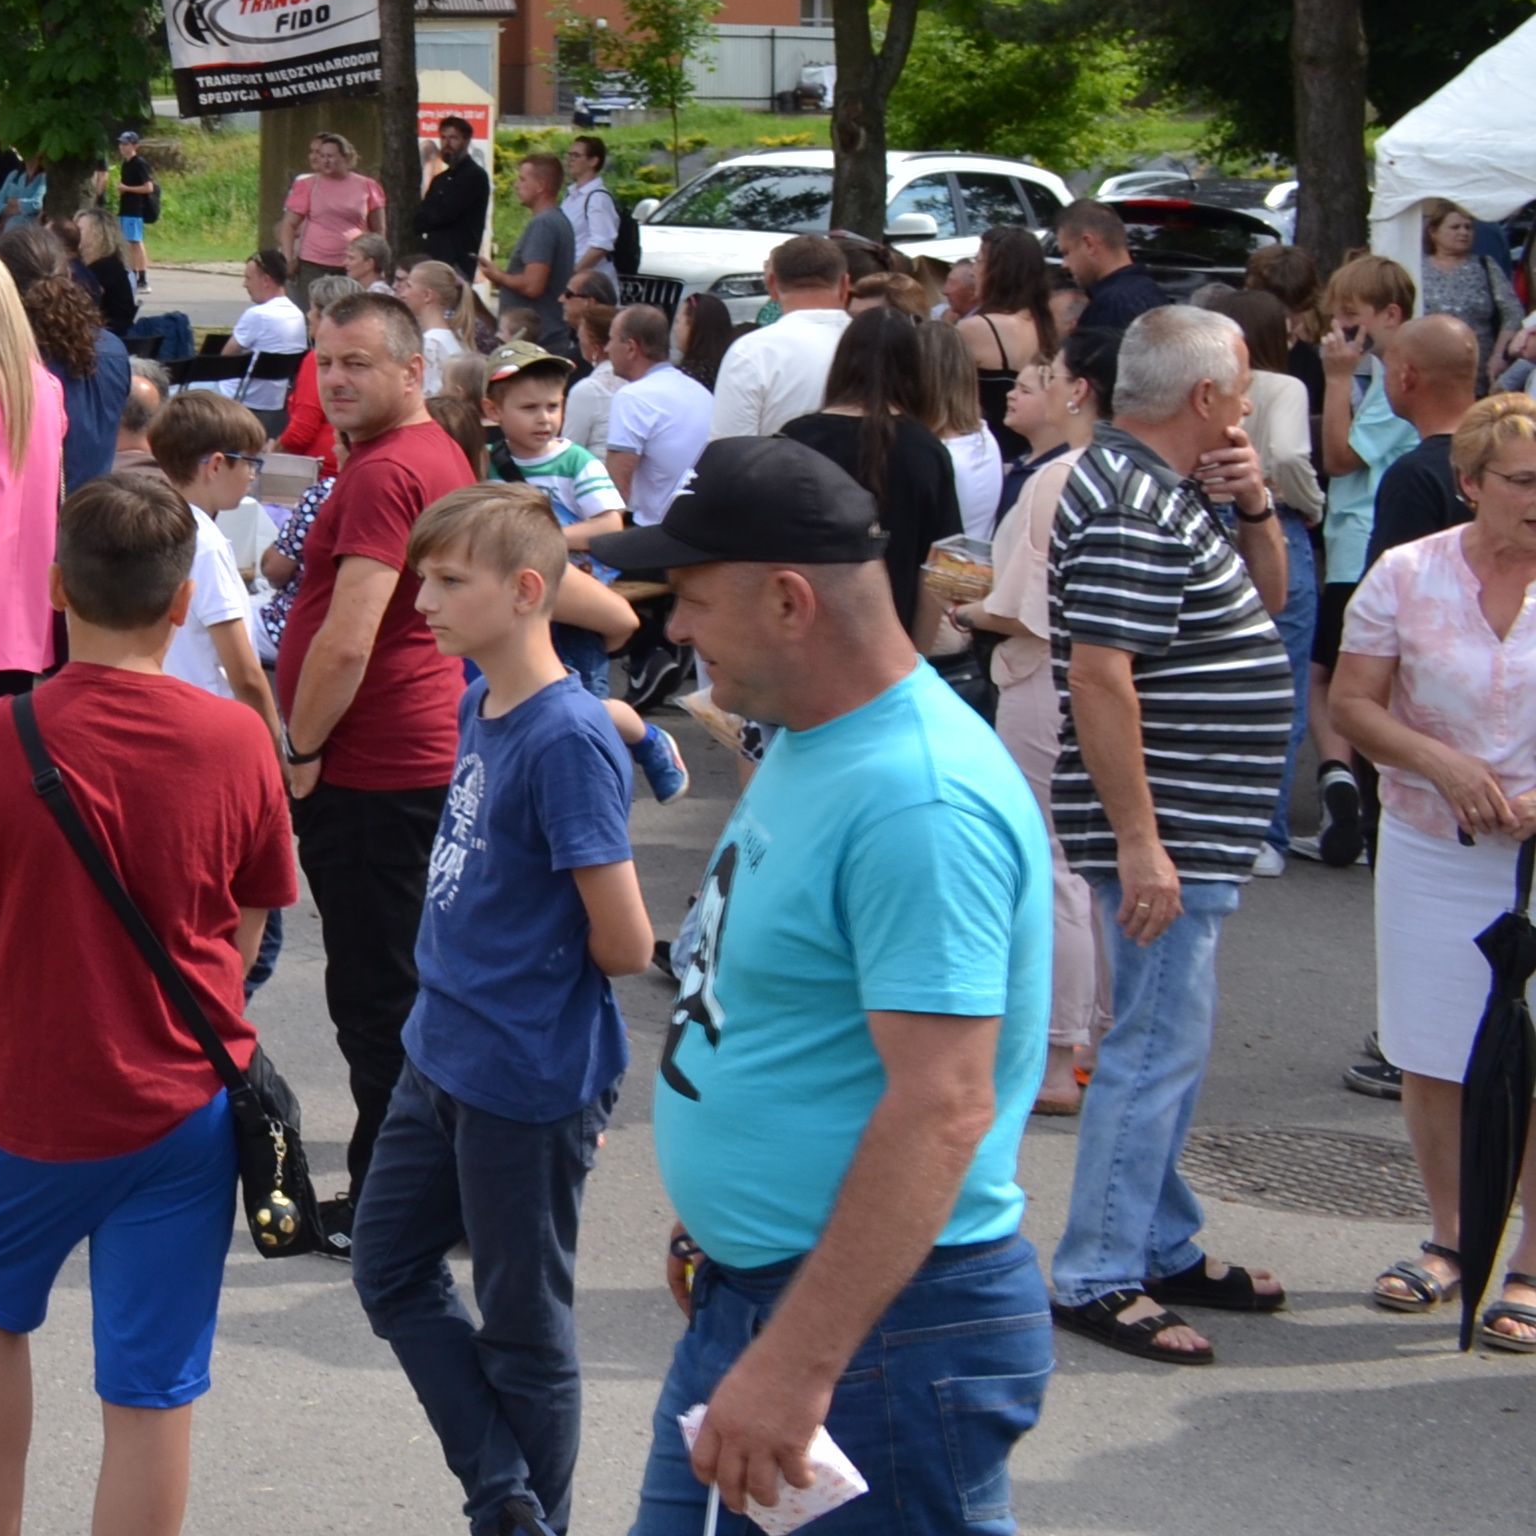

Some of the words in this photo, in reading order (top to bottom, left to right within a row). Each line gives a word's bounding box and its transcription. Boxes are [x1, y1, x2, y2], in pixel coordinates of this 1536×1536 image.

[275, 4, 331, 33] FIDO
[196, 73, 264, 88] TRANSPORT
[198, 88, 262, 105] SPEDYCJA
[270, 76, 344, 99] MATERIAŁY
